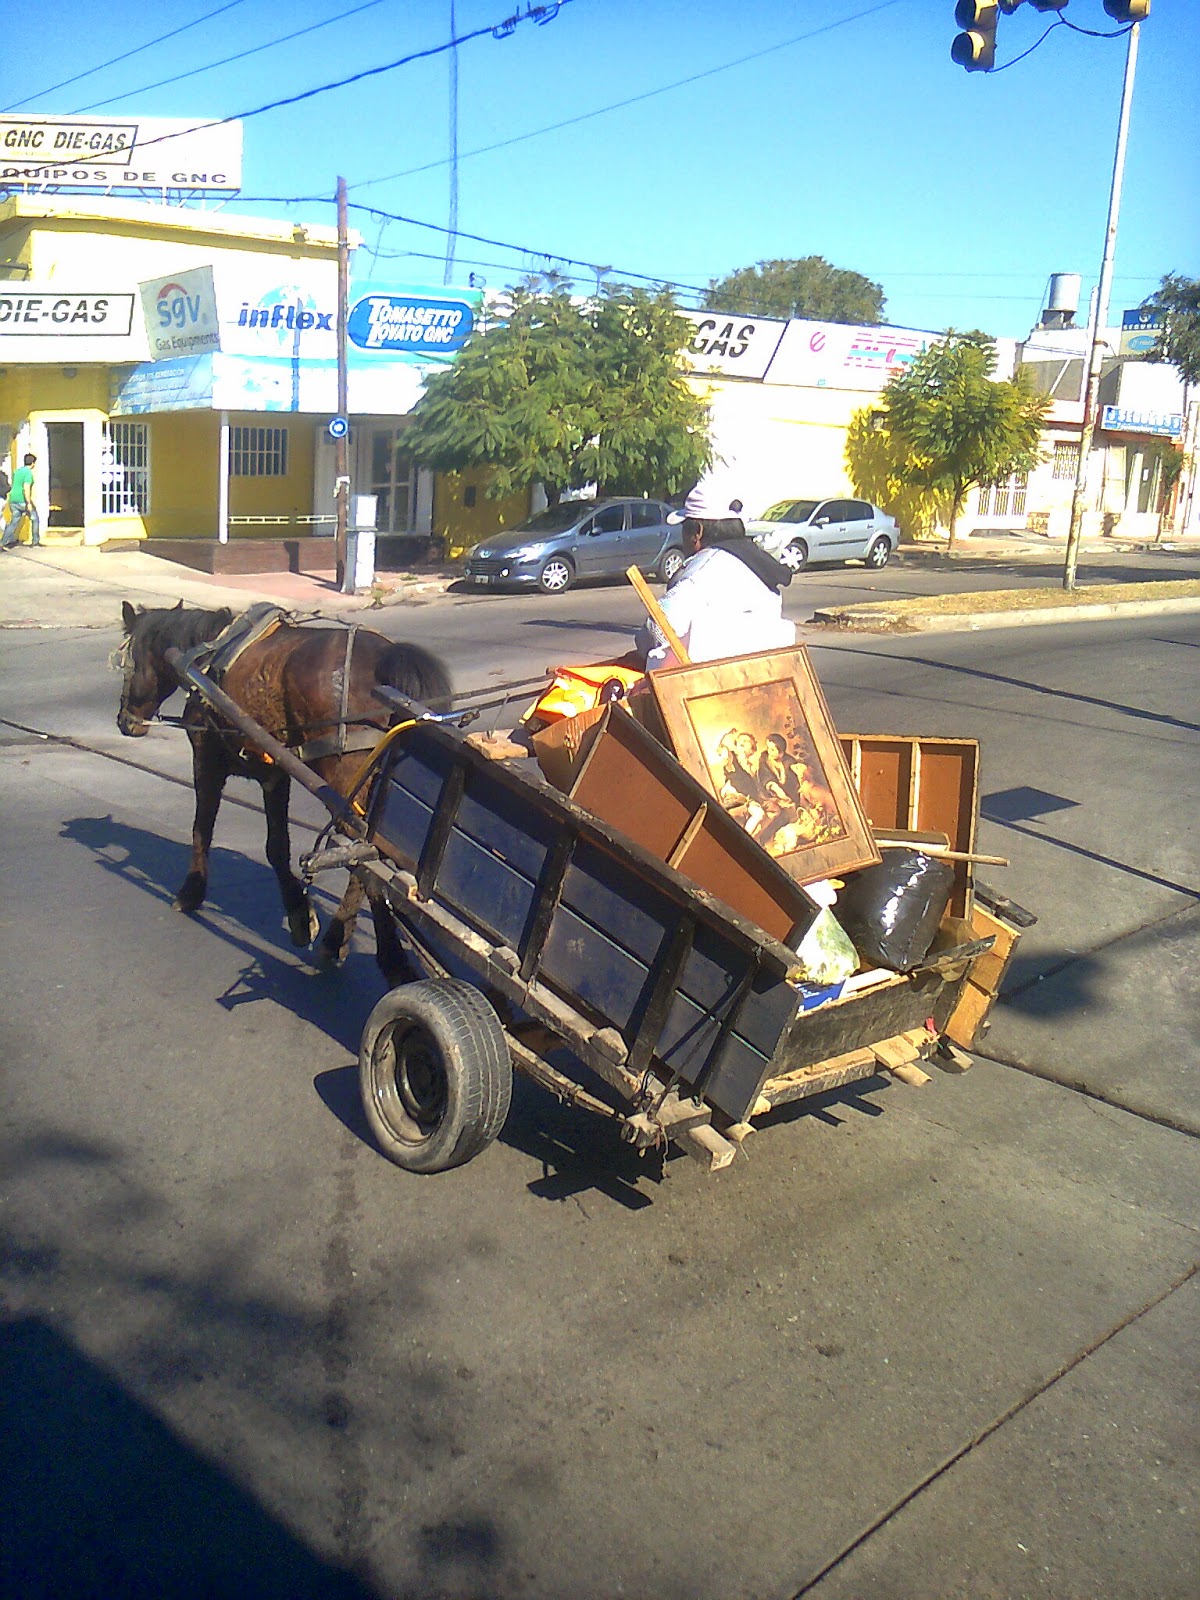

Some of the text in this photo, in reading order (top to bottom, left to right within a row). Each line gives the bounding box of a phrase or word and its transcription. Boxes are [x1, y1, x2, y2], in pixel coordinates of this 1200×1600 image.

[4, 130, 45, 149] GNC
[124, 172, 156, 182] DE
[172, 173, 227, 184] GNC
[156, 294, 200, 329] sgv
[238, 301, 335, 331] inflex
[368, 298, 462, 328] TOMASETTO
[156, 338, 171, 351] Gas
[366, 322, 455, 347] LOVATO GNC
